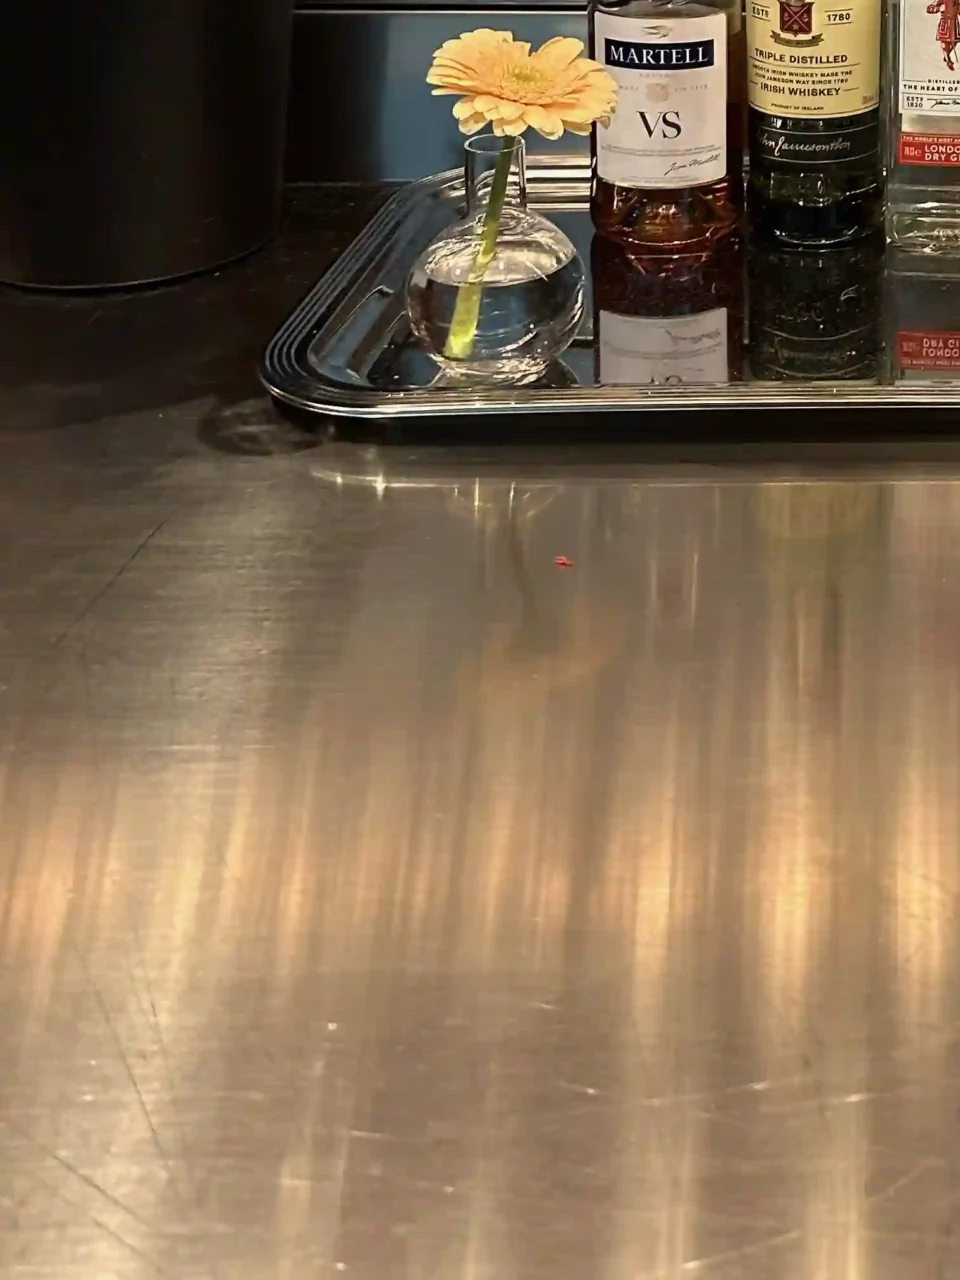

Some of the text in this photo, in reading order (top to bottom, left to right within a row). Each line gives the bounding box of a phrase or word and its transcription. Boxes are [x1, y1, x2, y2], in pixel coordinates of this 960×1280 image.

[610, 45, 709, 65] MARTELL
[755, 48, 848, 64] TRIPLE DISTILLED
[760, 83, 841, 97] IRISH WHISKEY
[636, 110, 682, 139] VS
[924, 153, 947, 161] DRY
